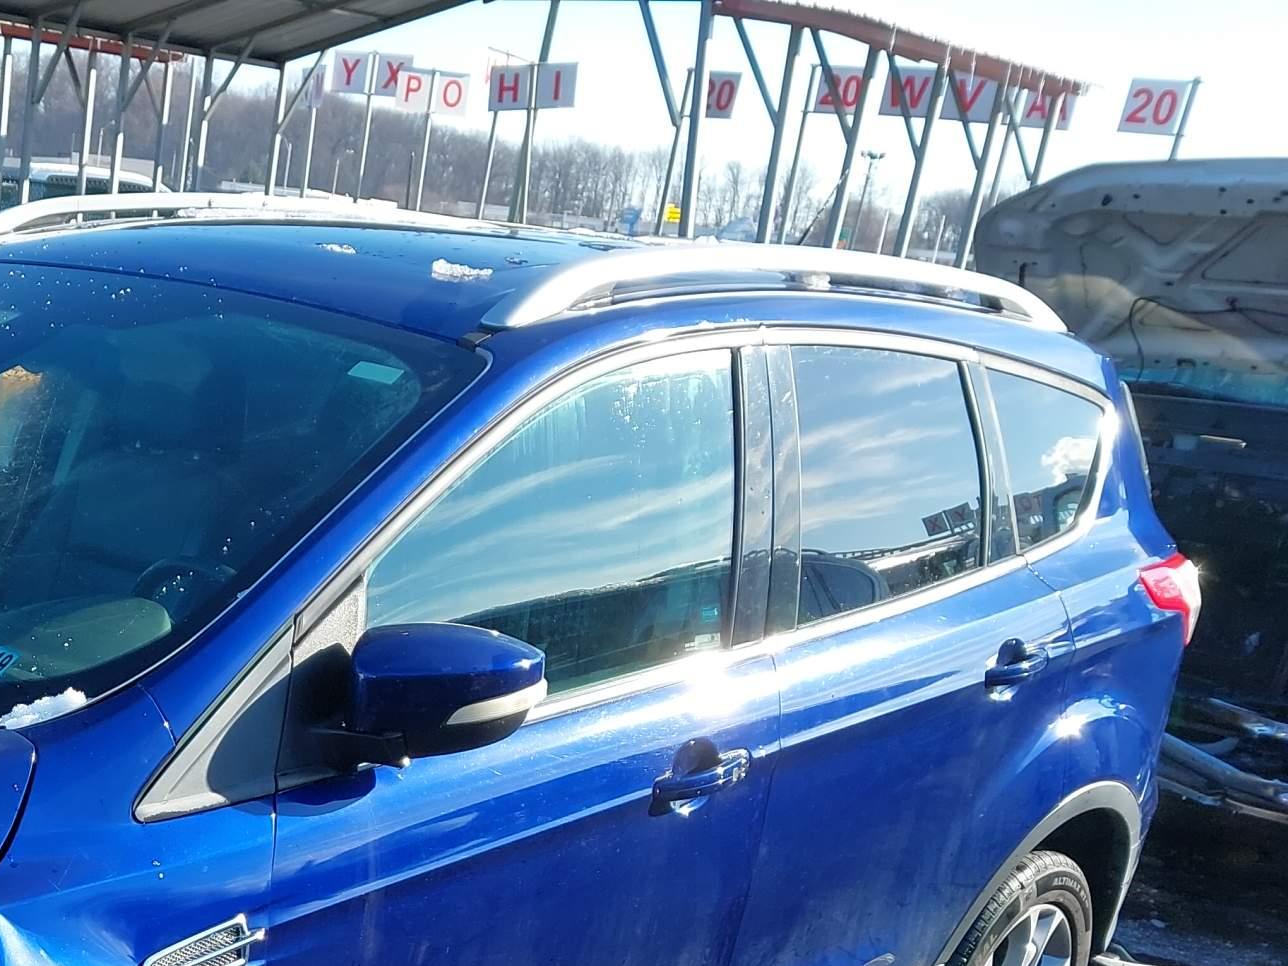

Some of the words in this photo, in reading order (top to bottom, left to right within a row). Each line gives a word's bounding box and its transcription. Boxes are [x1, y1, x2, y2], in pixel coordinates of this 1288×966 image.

[342, 57, 360, 86] Y
[382, 60, 404, 89] X
[404, 74, 421, 103] P
[497, 72, 519, 104] H
[955, 78, 988, 113] V
[1124, 87, 1177, 126] 20
